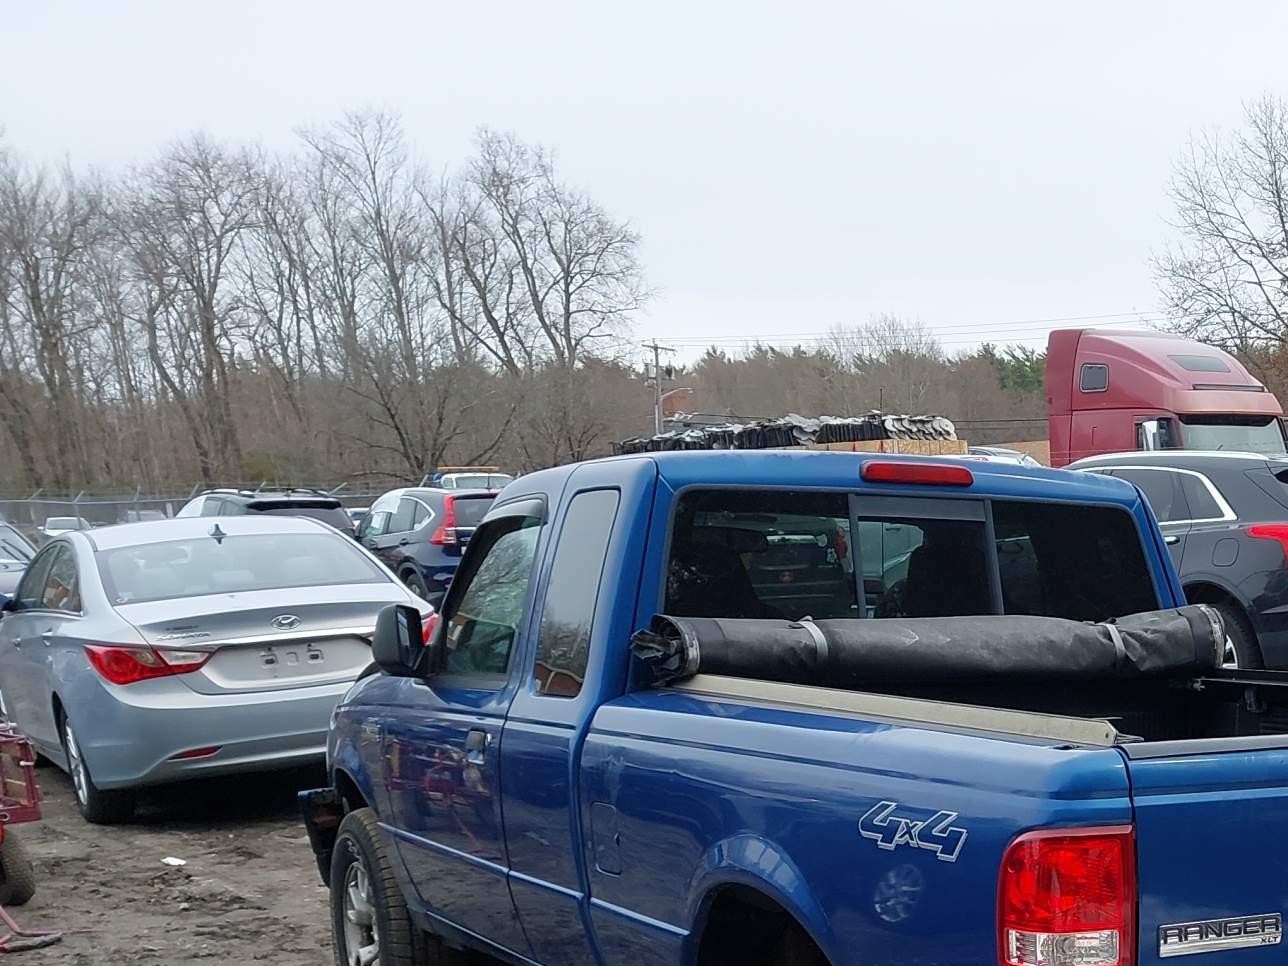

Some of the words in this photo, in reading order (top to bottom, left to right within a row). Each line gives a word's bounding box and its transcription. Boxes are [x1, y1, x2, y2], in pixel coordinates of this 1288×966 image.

[858, 800, 968, 863] 4x4
[1162, 916, 1281, 945] RANGER
[1260, 935, 1279, 944] XLT
